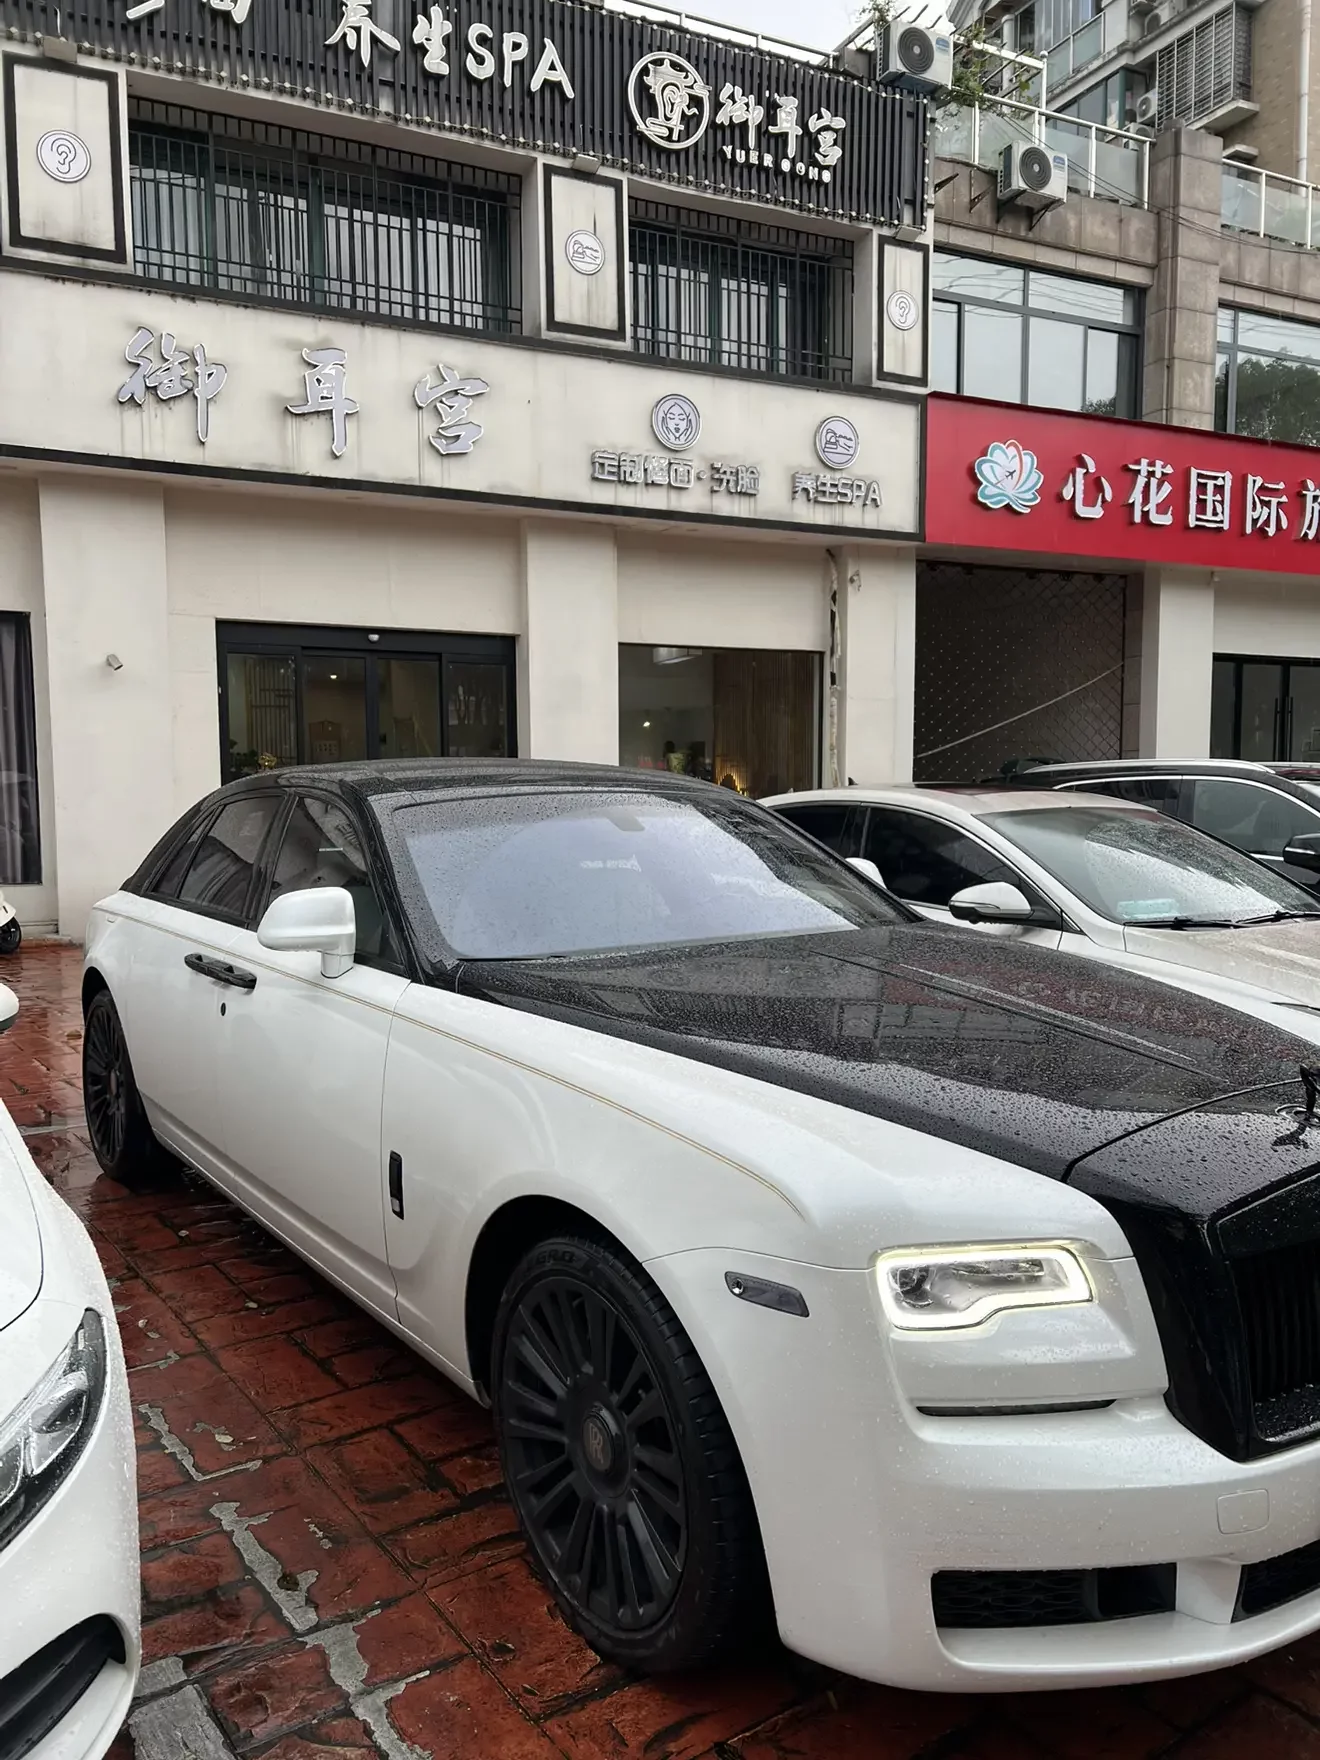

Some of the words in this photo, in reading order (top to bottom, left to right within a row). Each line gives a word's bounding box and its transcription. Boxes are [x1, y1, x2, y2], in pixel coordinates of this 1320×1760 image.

[715, 82, 846, 166] 御耳宫
[118, 326, 490, 457] 御耳宫
[791, 471, 883, 507] 养生SPA
